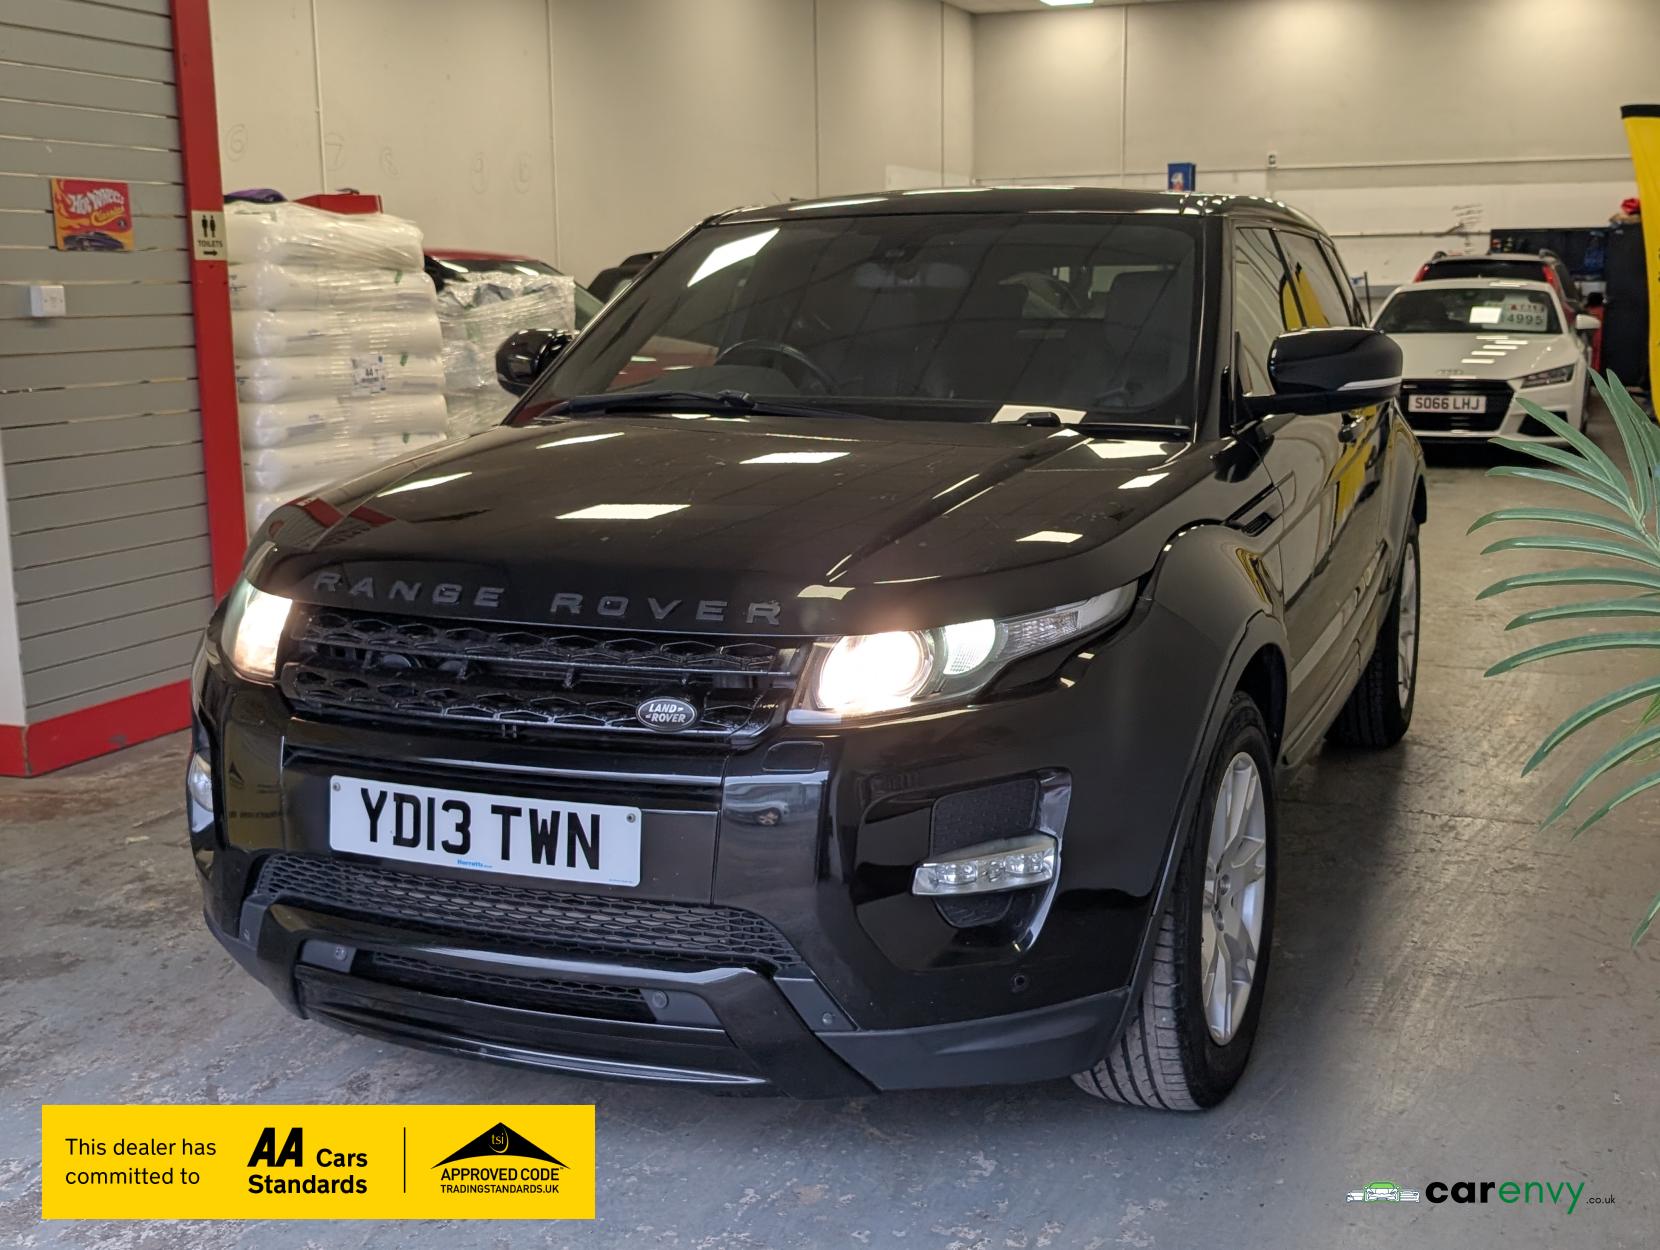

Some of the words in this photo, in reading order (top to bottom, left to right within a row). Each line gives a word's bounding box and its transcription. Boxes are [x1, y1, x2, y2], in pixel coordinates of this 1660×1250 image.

[198, 240, 223, 248] TOILETS
[1453, 397, 1480, 411] LHJ
[313, 571, 504, 608] RANGE
[550, 592, 782, 626] ROVER
[649, 703, 677, 713] LAND
[651, 713, 686, 723] ROVER
[360, 787, 472, 856] YD13
[490, 803, 601, 871] TWN
